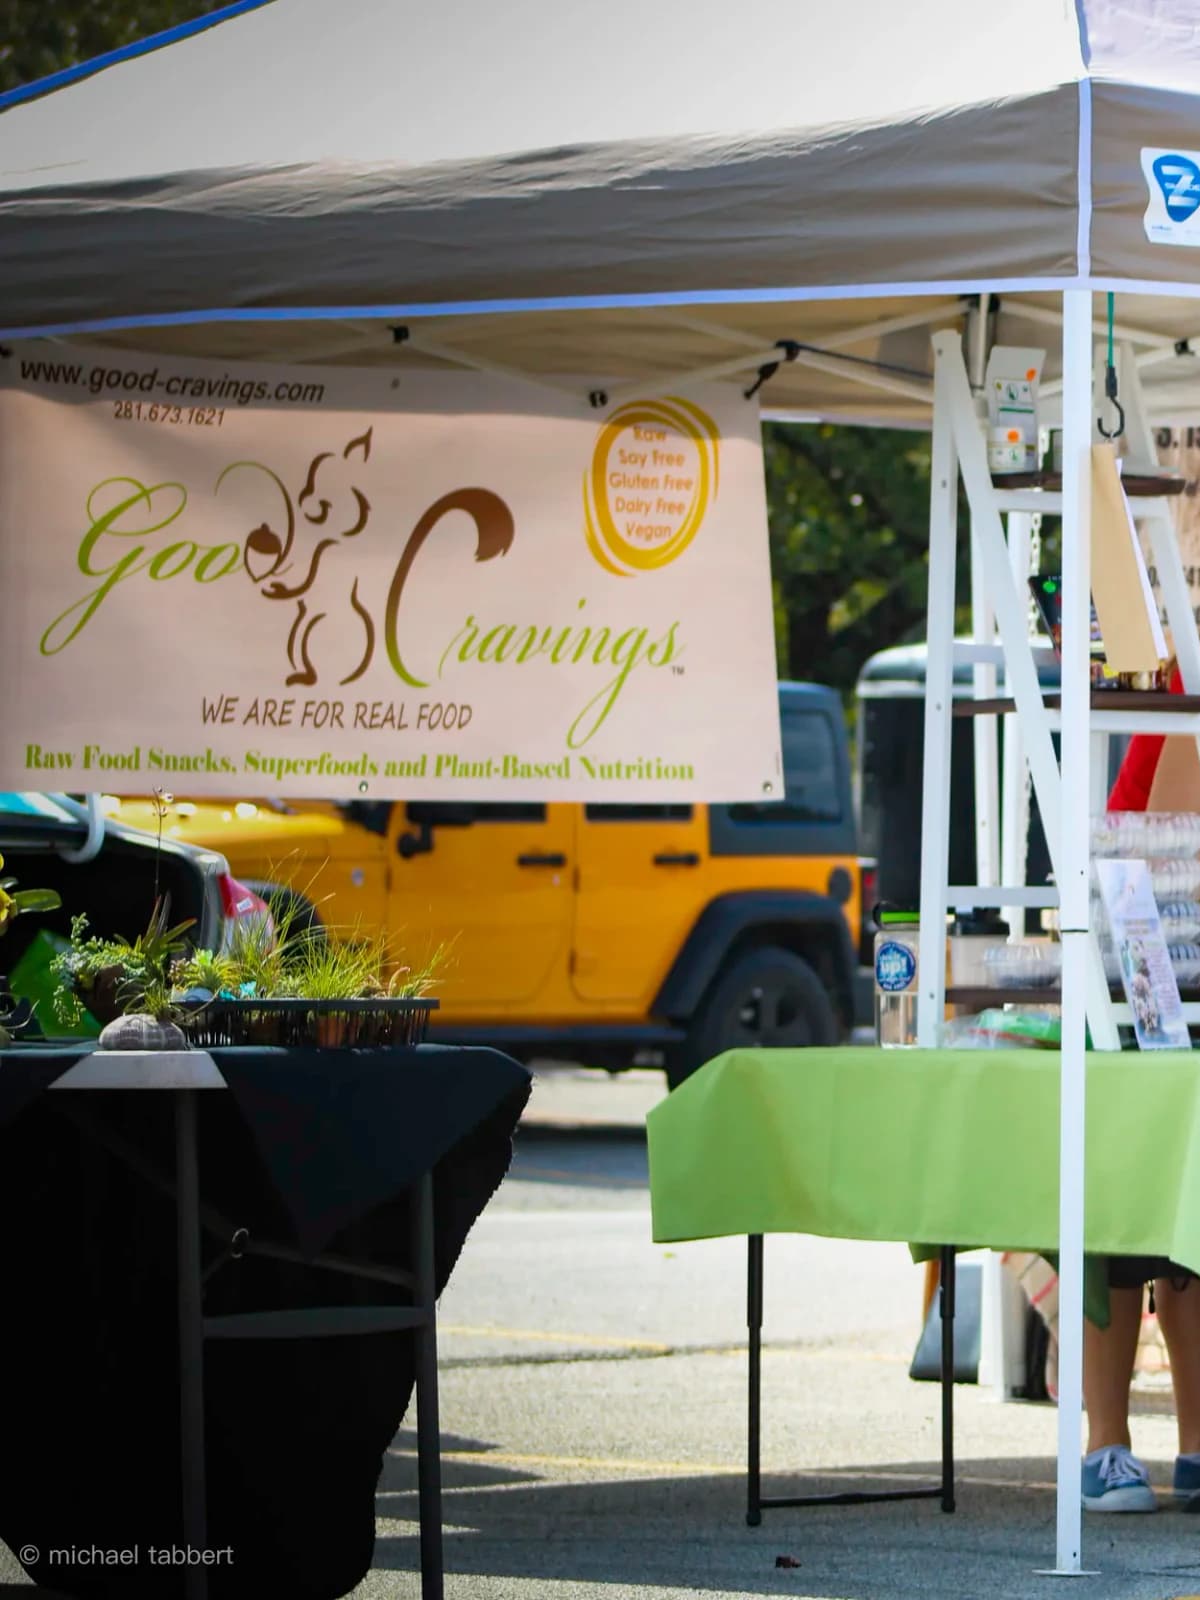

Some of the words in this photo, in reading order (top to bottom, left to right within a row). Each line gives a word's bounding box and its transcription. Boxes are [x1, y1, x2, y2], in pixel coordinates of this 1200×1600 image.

[20, 360, 325, 405] www.good-cravings.com
[114, 402, 225, 426] 281.673.1621
[633, 426, 667, 441] Raw
[618, 449, 648, 468] Soy
[609, 472, 659, 489] Gluten
[615, 496, 651, 516] Dairy
[625, 522, 672, 542] Vegan
[384, 486, 688, 750] Cravings
[201, 694, 239, 726] WE
[242, 698, 296, 727] ARE
[301, 700, 345, 729] FOR
[353, 702, 409, 731] REAL
[416, 703, 473, 731] FOOD
[25, 744, 76, 770] Raw
[83, 745, 141, 771] Food
[243, 751, 379, 781] Superfoods
[384, 754, 427, 777] and
[434, 754, 571, 780] Plant-Based
[579, 756, 695, 781] Nutrition
